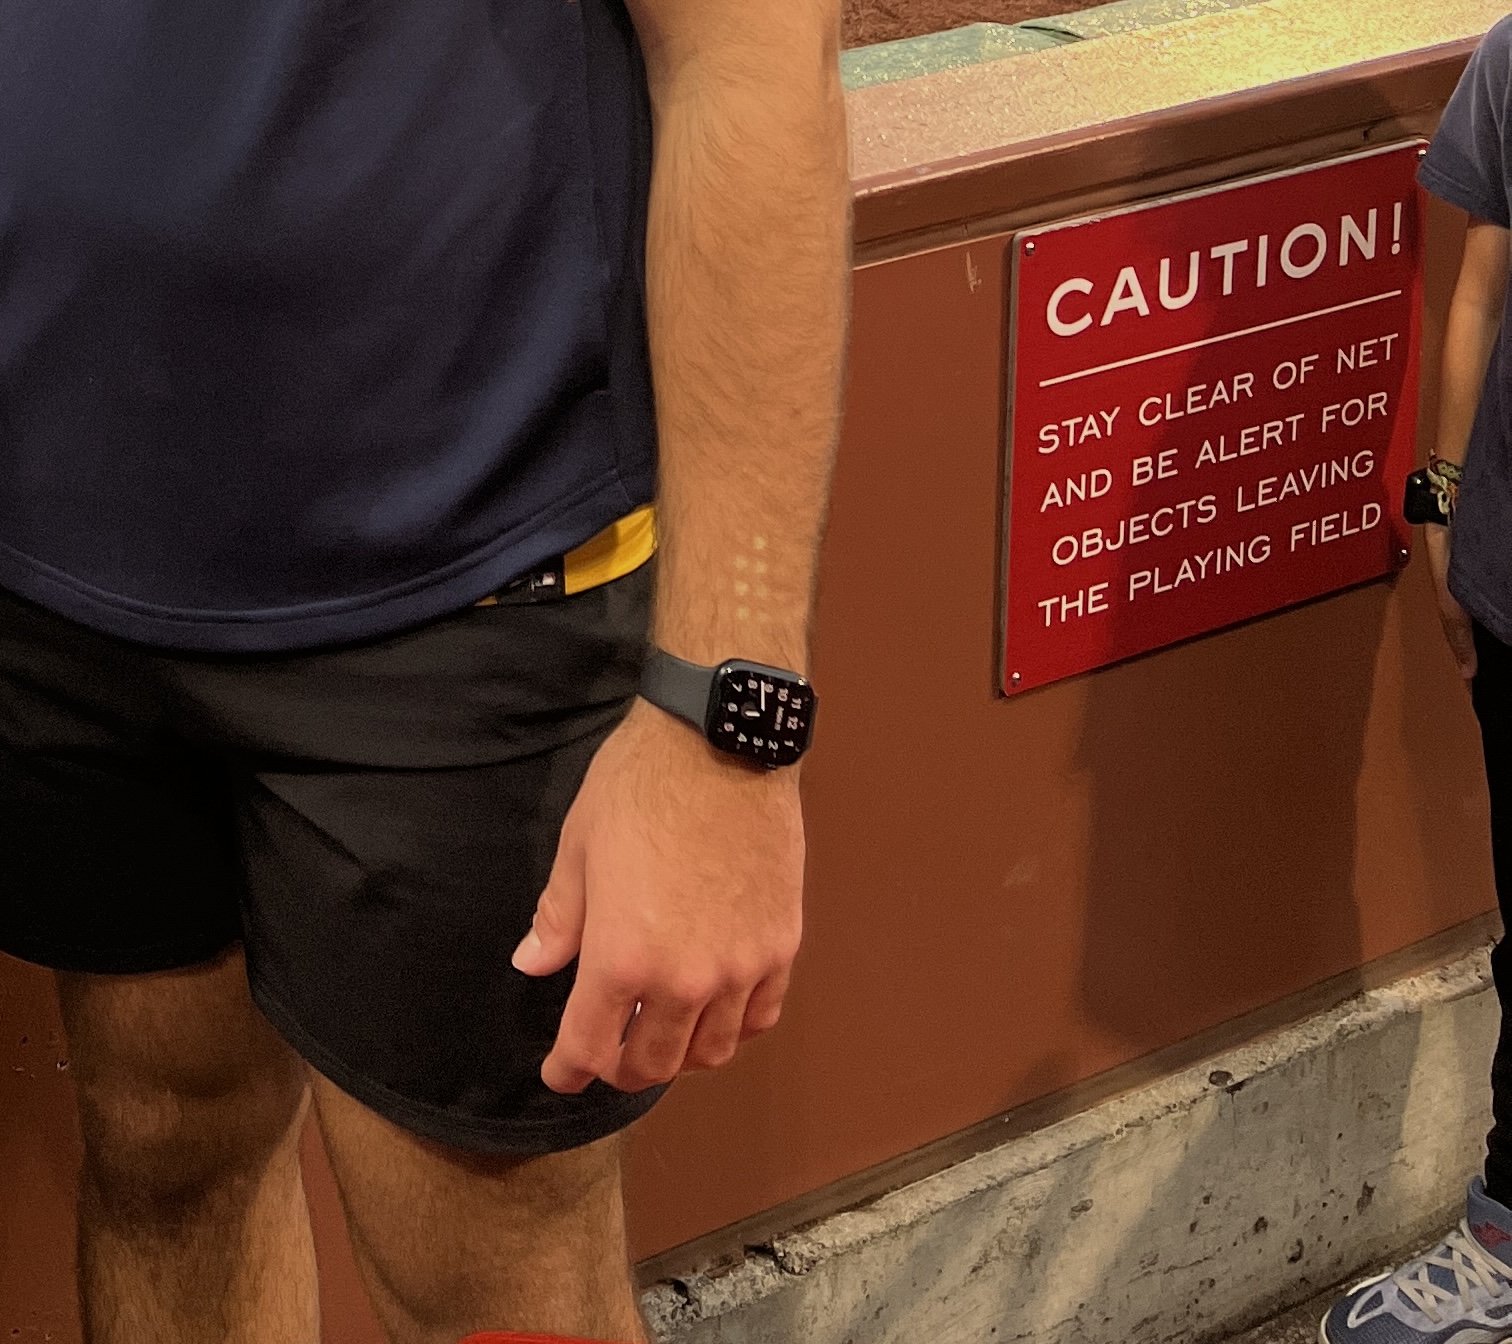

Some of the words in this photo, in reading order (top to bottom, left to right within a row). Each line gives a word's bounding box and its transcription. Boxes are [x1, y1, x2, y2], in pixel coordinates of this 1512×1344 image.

[1046, 201, 1404, 338] CAUTION!
[1037, 405, 1121, 455] STAY
[1138, 371, 1255, 427] CLEAR
[1272, 354, 1320, 390] OF
[1336, 332, 1400, 375] NET
[1039, 468, 1113, 513] AND
[1131, 448, 1179, 487] BE
[1194, 413, 1305, 470] ALERT
[1321, 390, 1389, 434] FOR
[1050, 495, 1218, 567] OBJECTS
[1236, 450, 1375, 514] LEAVING
[1037, 582, 1110, 628] THE
[1128, 535, 1272, 602] PLAYING
[1289, 502, 1382, 553] FIELD
[786, 715, 799, 730] 12
[791, 697, 802, 710] 11
[737, 732, 747, 743] 4
[753, 736, 764, 747] 3
[768, 739, 779, 751] 2
